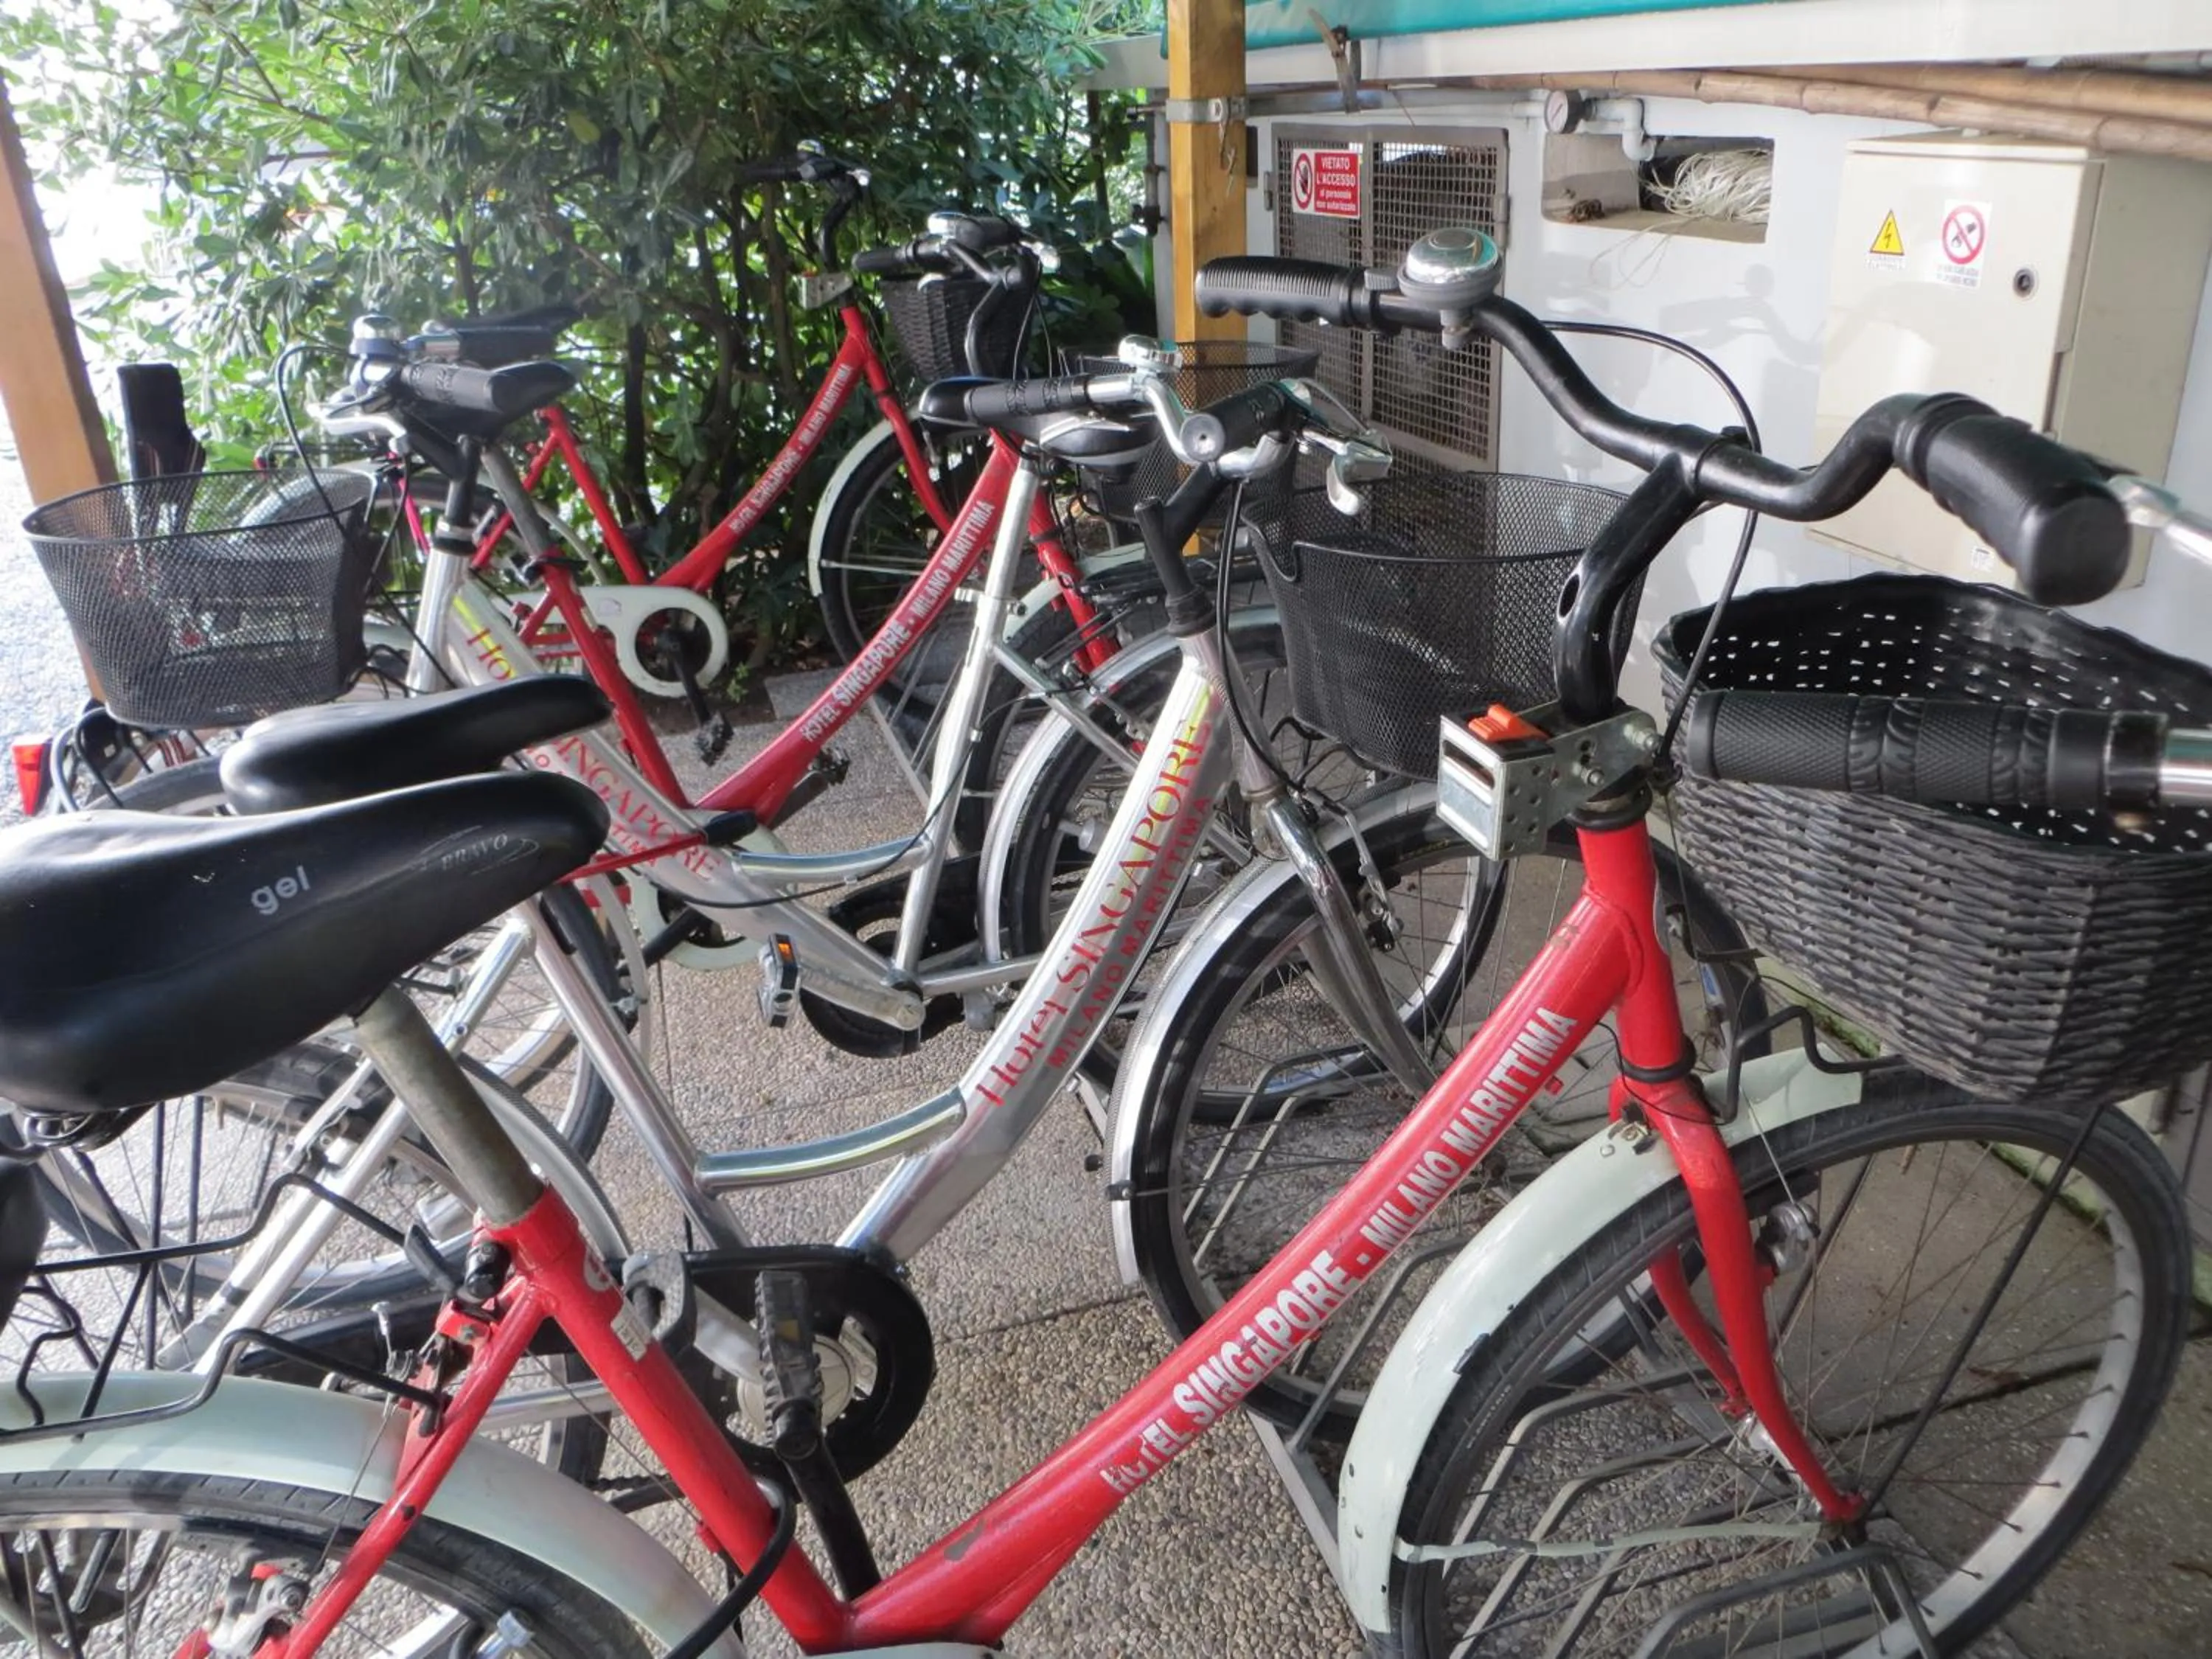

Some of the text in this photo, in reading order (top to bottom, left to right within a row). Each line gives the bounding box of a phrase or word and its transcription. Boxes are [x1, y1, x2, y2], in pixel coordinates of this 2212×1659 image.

[1316, 172, 1356, 187] L'ACCESSO
[1321, 156, 1350, 170] VIETATO
[799, 701, 841, 742] HOTEL
[830, 619, 912, 707] SINGAPORE
[911, 571, 952, 619] MILANO
[943, 499, 995, 573] MARITTIMA
[251, 865, 310, 916] gel
[1045, 795, 1211, 1069] MILANO MARITTIMA
[1055, 719, 1213, 994] SINGAPORE
[1172, 1250, 1355, 1429] SINGAPORE
[1361, 1150, 1461, 1253] MILANO
[1440, 1005, 1579, 1166] MARITTIMA
